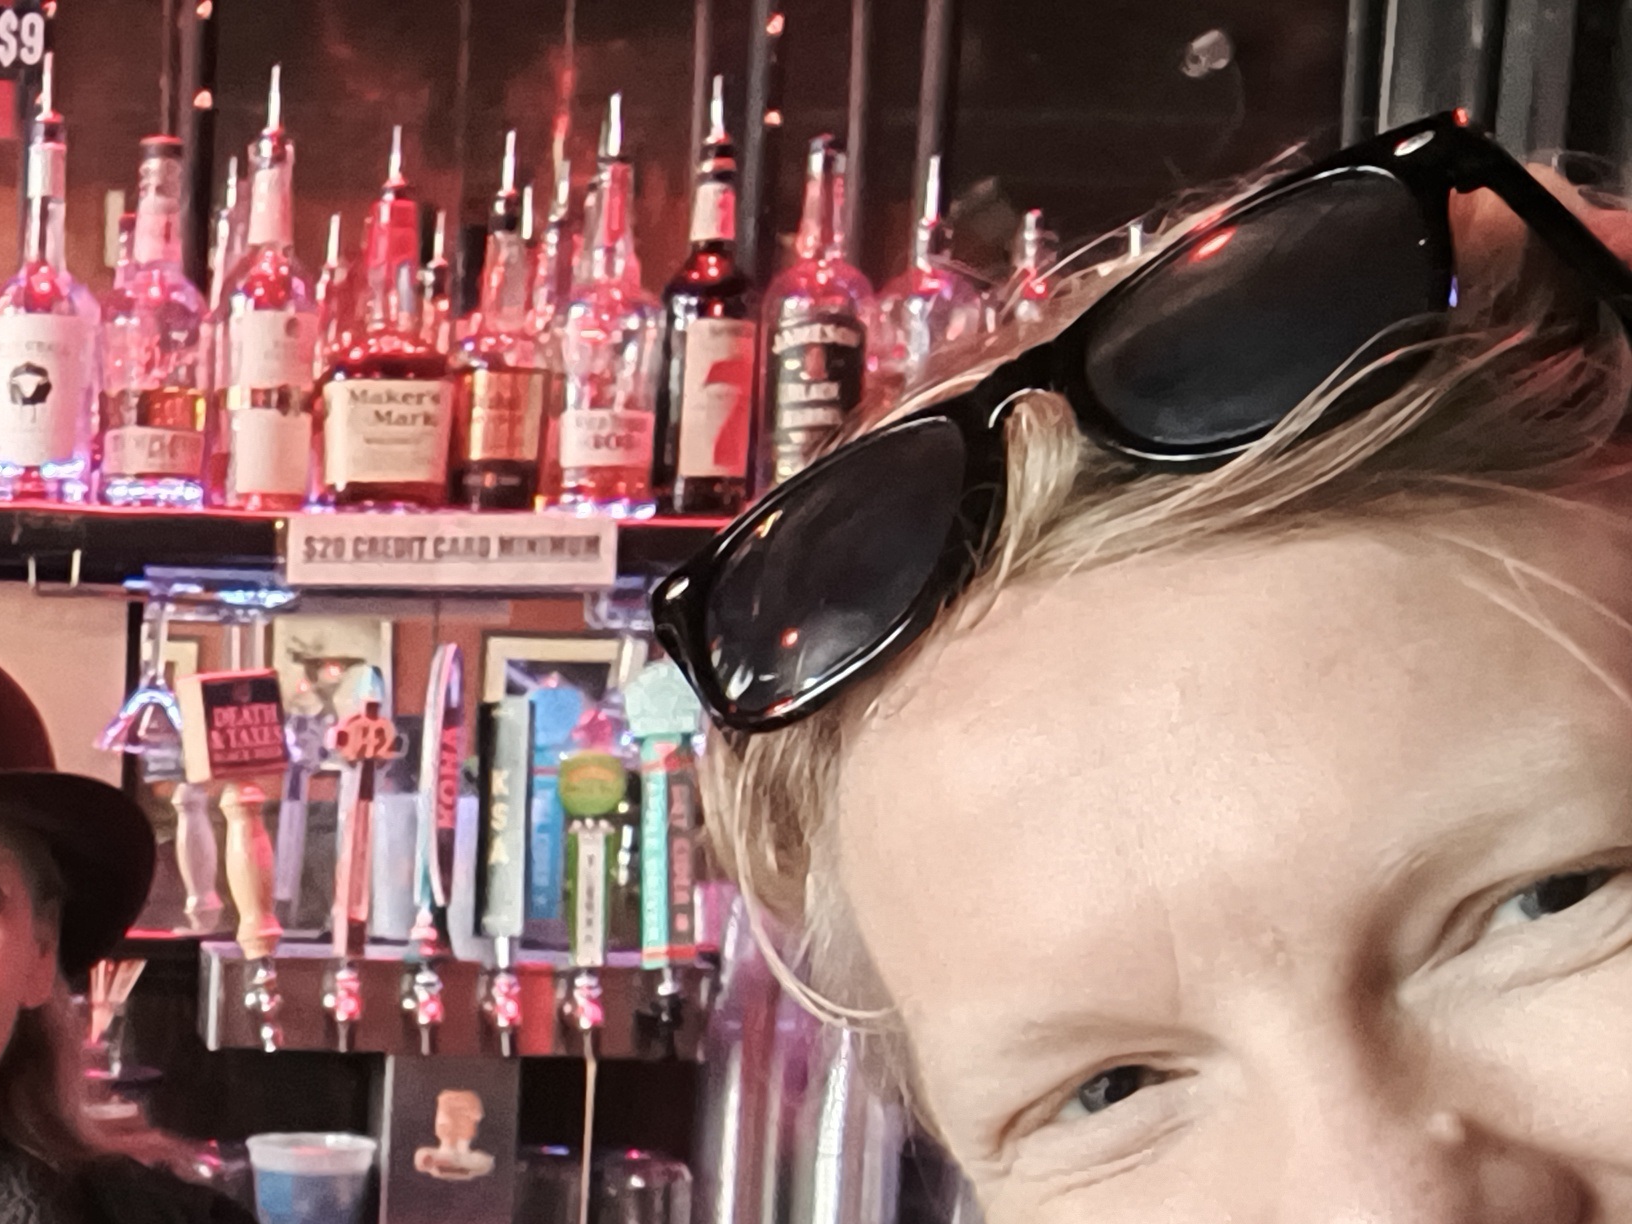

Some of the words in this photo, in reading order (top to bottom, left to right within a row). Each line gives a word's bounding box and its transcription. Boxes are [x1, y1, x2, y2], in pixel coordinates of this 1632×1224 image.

[348, 388, 441, 406] Maker's
[373, 409, 438, 427] Mark
[304, 535, 346, 560] $20
[352, 535, 427, 560] CREDIT
[433, 535, 492, 560] CARD
